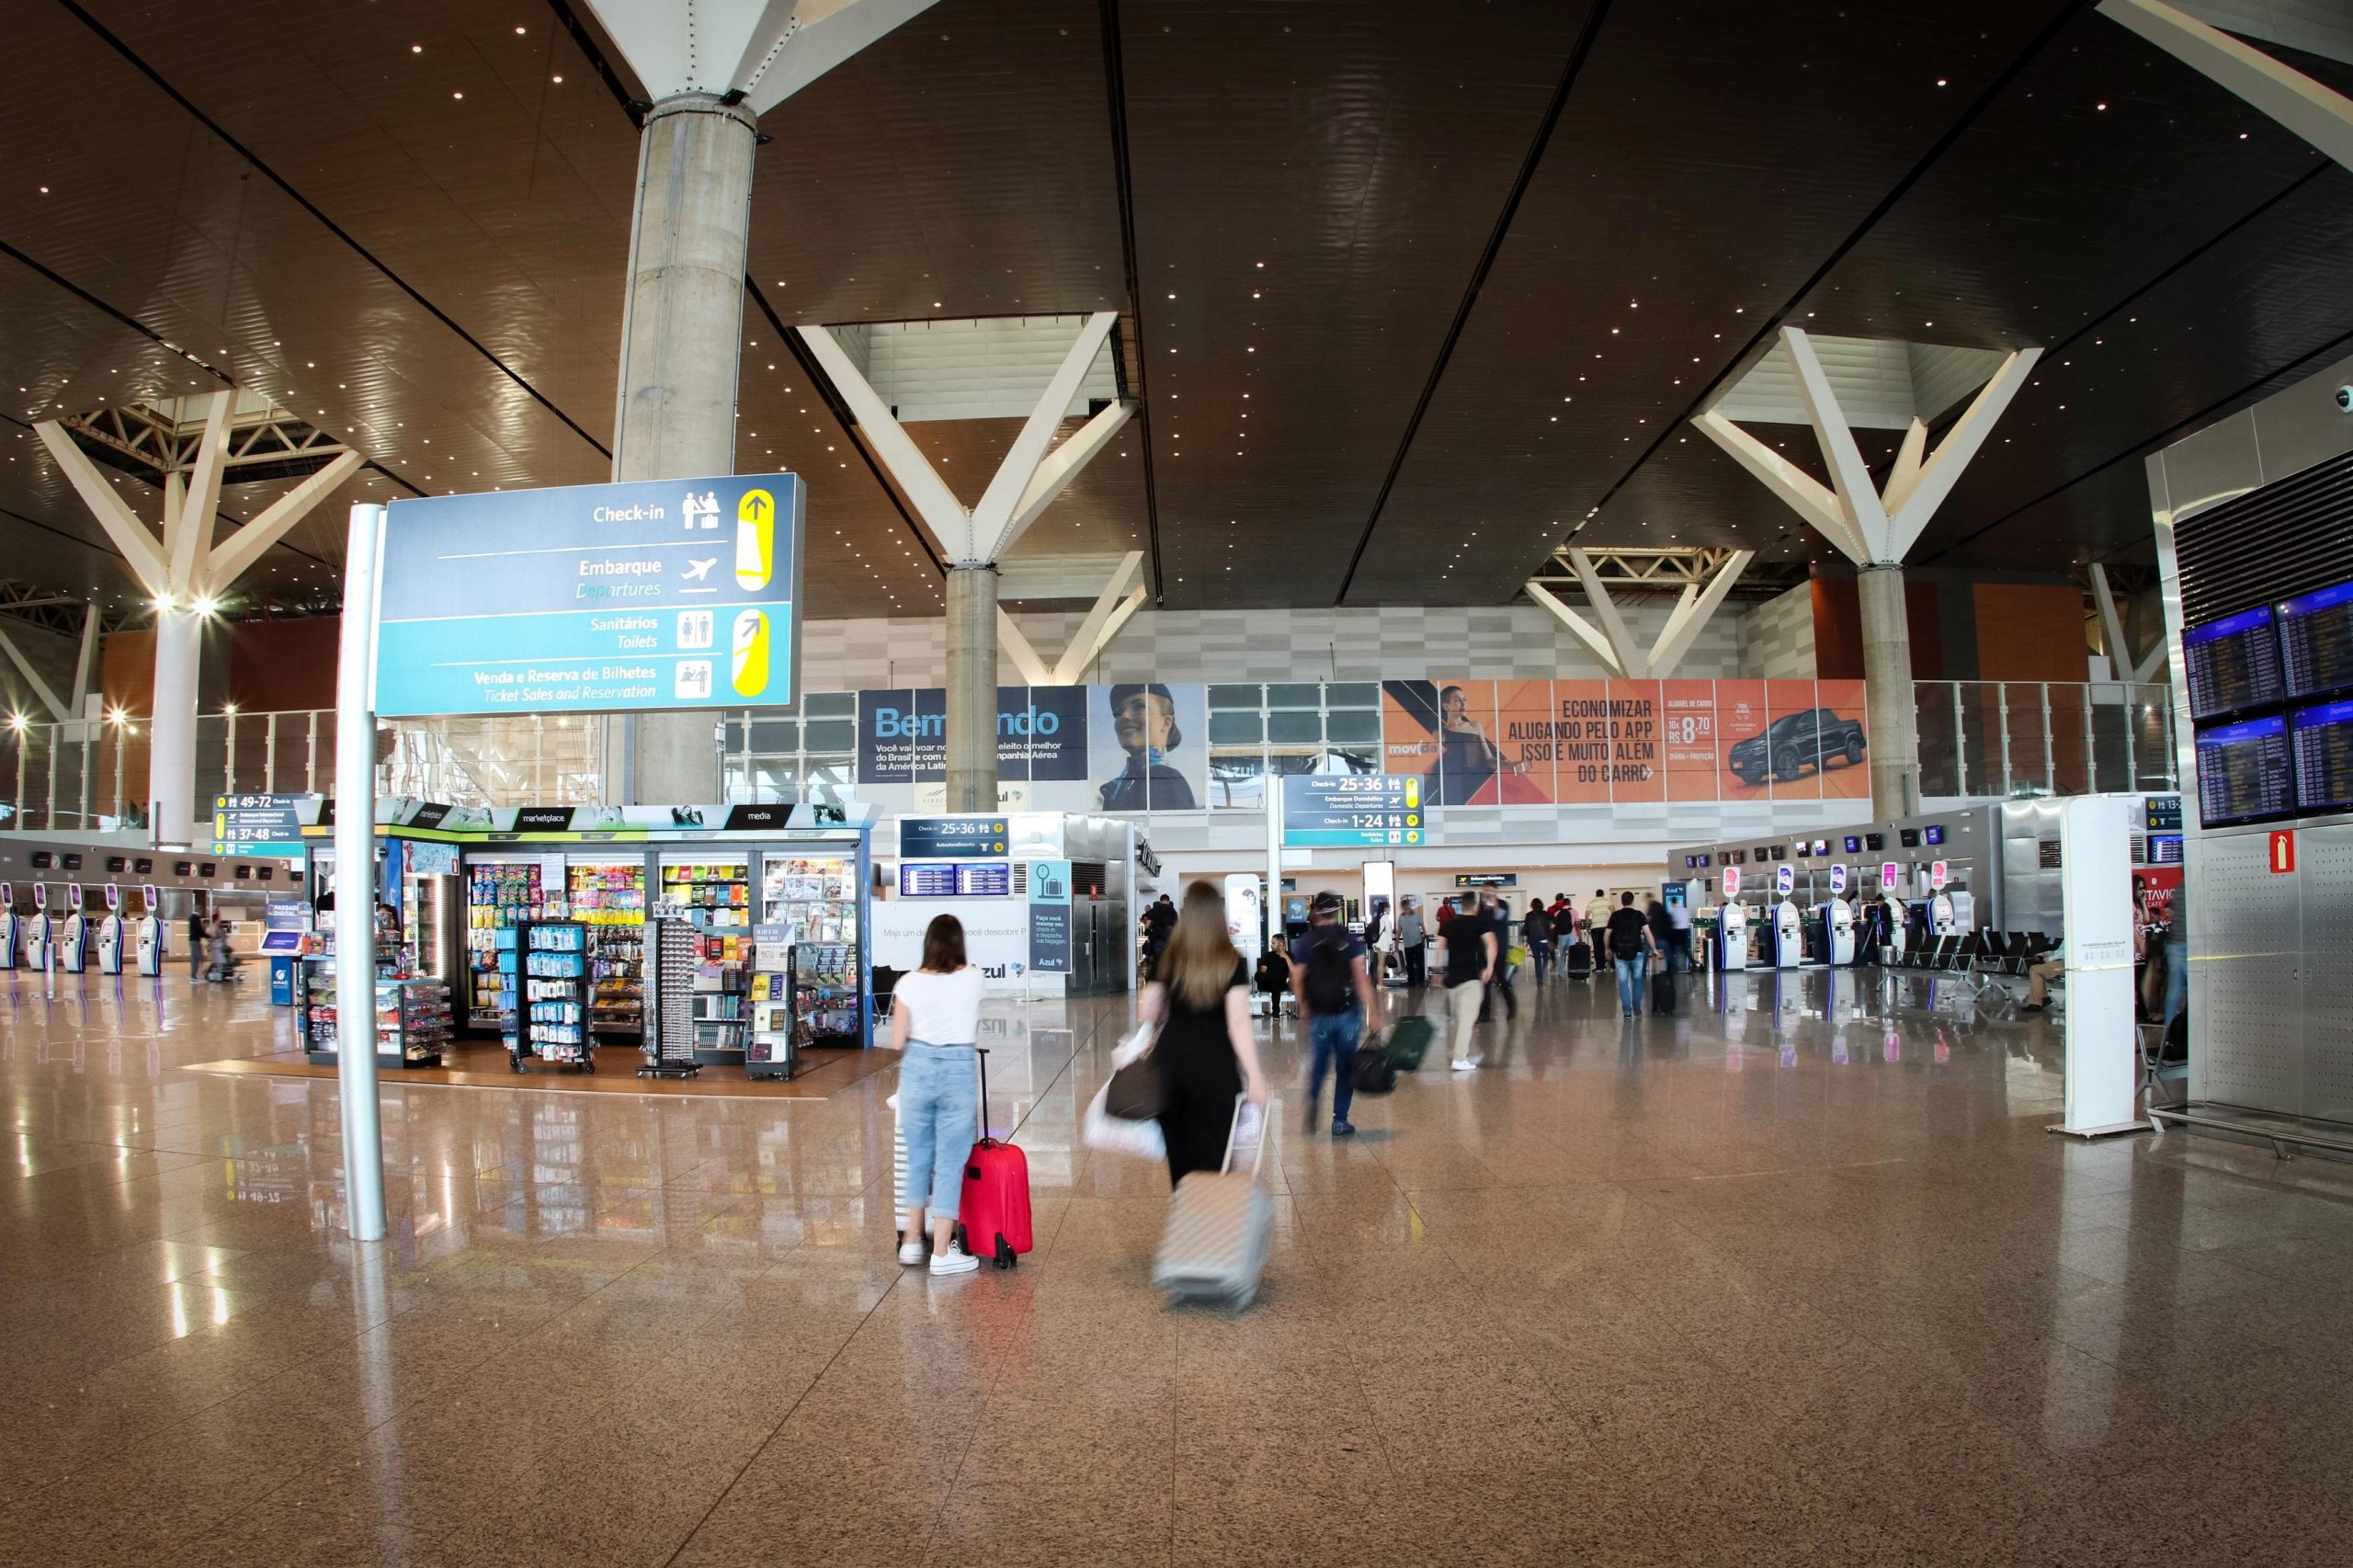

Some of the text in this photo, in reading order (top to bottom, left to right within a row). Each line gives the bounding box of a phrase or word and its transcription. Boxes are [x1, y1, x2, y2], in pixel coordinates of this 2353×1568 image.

[593, 504, 665, 523] Check-in
[579, 559, 662, 577] Embarque
[575, 582, 662, 601] Departures
[591, 617, 658, 631] Sanitários
[617, 635, 658, 649] Toilets
[474, 665, 656, 685] Venda e Reserva de Bilhetes
[484, 685, 656, 702] Ticket Sales and Reservation
[1563, 699, 1652, 718] ECONOMIZAR
[1508, 722, 1581, 740] ALUGANDO
[1586, 722, 1619, 739] PELO
[900, 744, 912, 752] vai
[998, 742, 1022, 750] eleito
[1031, 742, 1062, 750] melhor
[1521, 739, 1654, 761] ISSO É MUITO ALÉM
[876, 754, 887, 762] do
[1031, 750, 1058, 759] Aérea
[876, 763, 887, 771] da
[888, 762, 926, 771] América
[1578, 765, 1597, 782] DO
[1339, 778, 1382, 791] 25-36
[240, 796, 271, 808] 49-72
[522, 814, 565, 824] marketplace
[1351, 814, 1383, 828] 1-24
[239, 828, 269, 840] 37-48
[941, 824, 975, 835] 25-36
[884, 928, 901, 938] Mais
[984, 927, 1019, 936] descobrir
[1039, 958, 1055, 966] Azul
[971, 964, 1006, 979] zul
